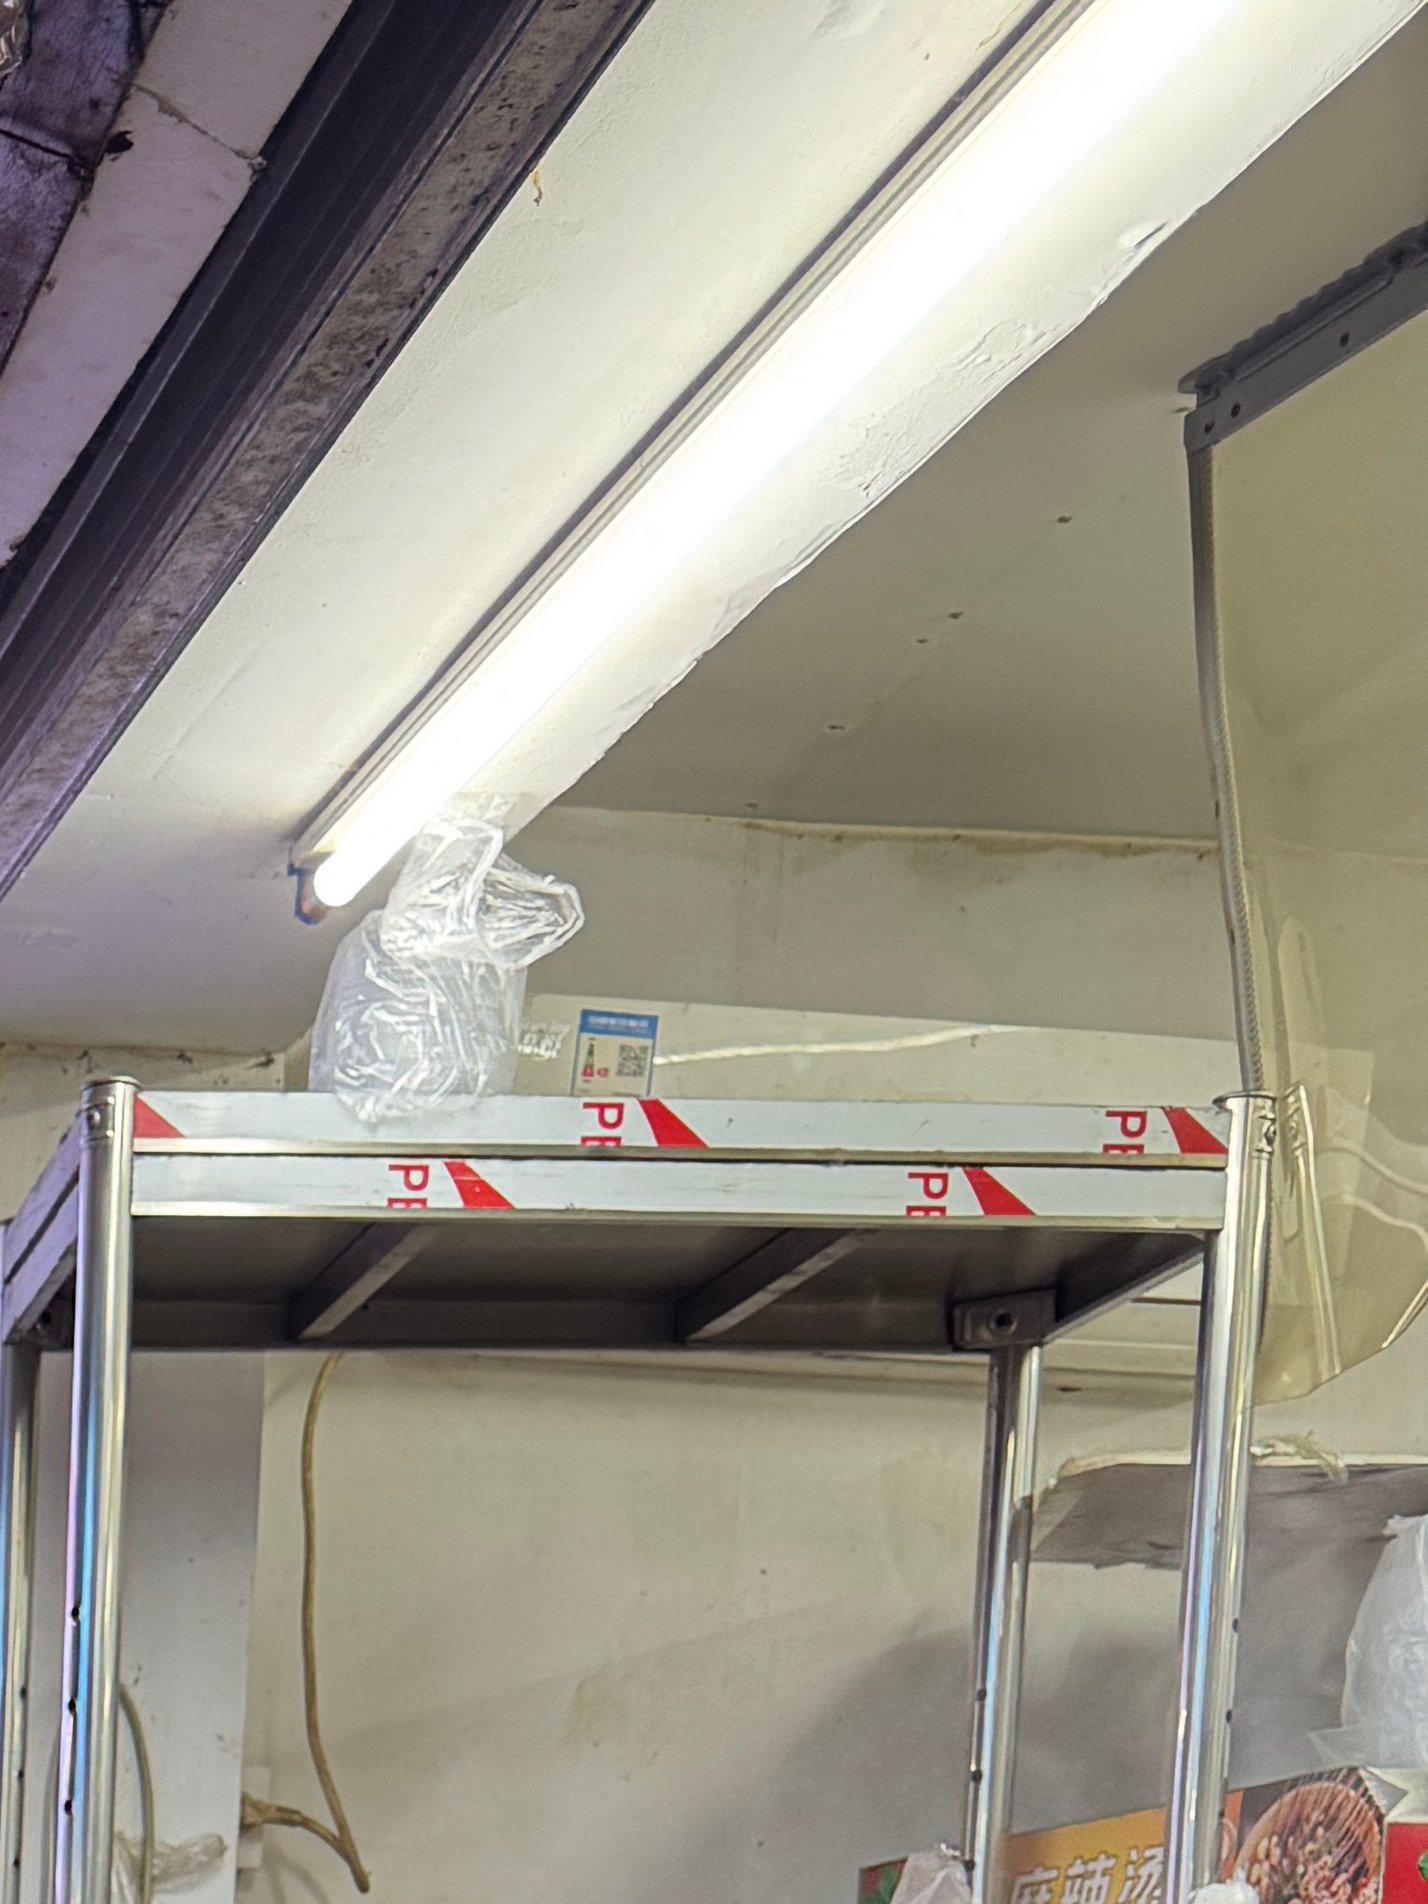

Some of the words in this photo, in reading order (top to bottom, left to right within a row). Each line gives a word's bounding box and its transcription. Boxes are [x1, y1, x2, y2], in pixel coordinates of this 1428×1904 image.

[580, 1102, 624, 1147] P
[1103, 1110, 1147, 1154] P
[387, 1164, 429, 1208] P
[906, 1172, 948, 1216] P
